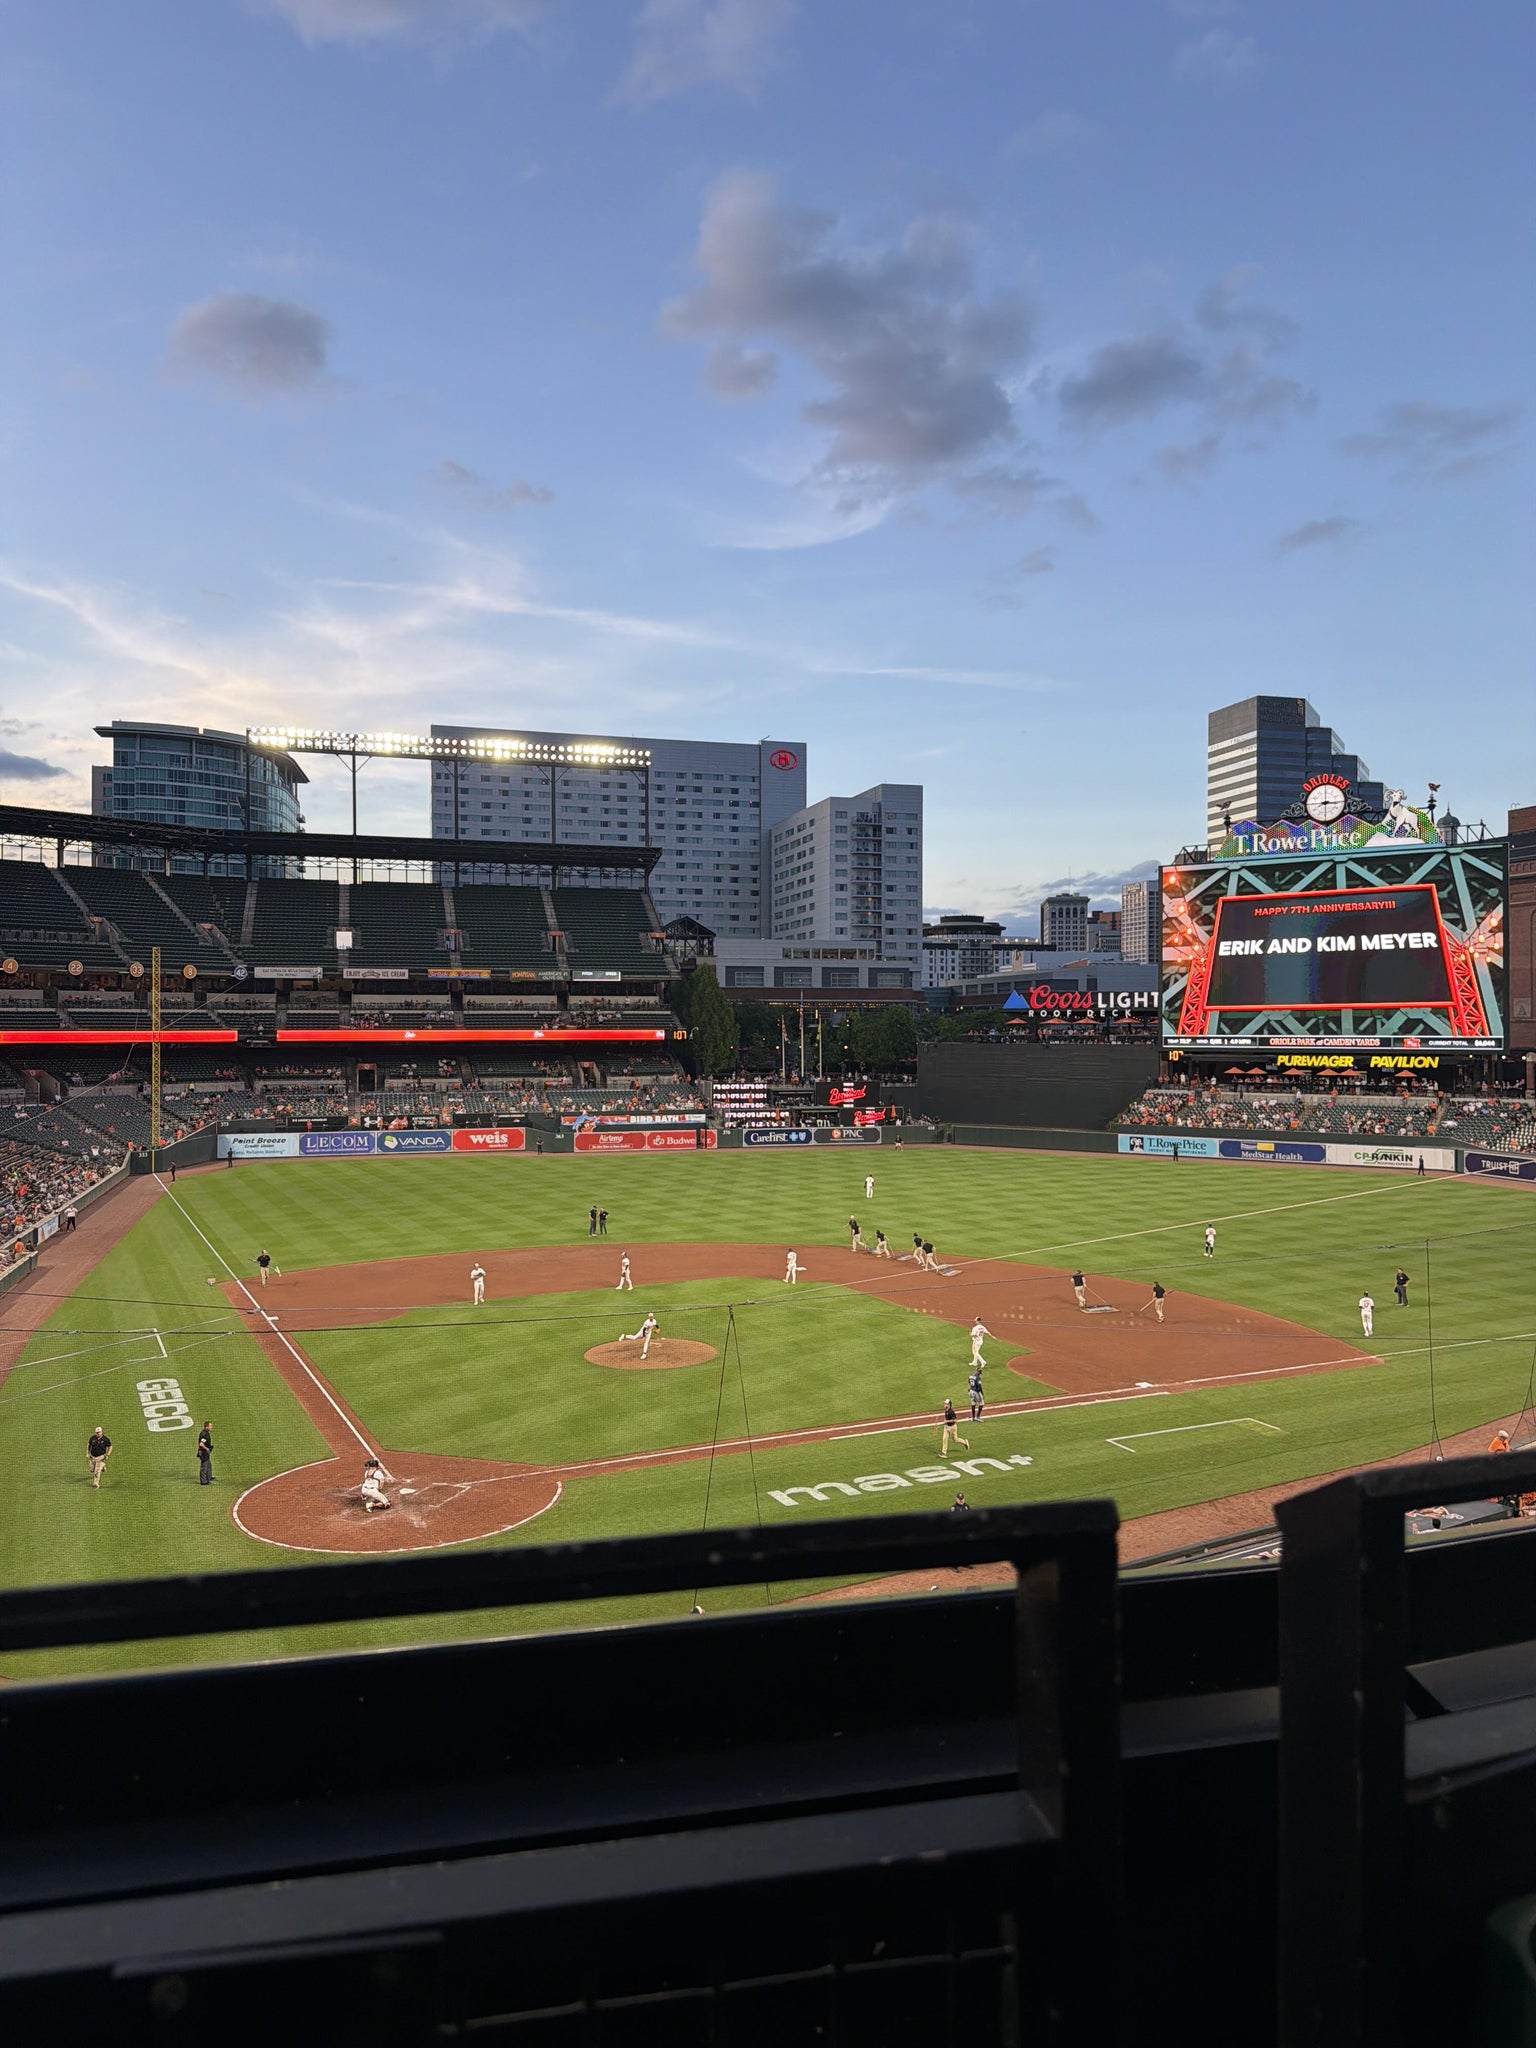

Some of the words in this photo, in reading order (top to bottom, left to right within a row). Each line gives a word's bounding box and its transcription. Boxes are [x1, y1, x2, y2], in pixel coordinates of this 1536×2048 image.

[1303, 773, 1350, 793] ORIOLES
[1310, 828, 1361, 849] Price
[1254, 907, 1288, 916] HAPPY
[1290, 906, 1310, 915] 7TH
[1218, 939, 1264, 956] ERIK
[1267, 937, 1312, 955] AND
[1317, 935, 1356, 952] KIM
[1361, 932, 1438, 951] MEYER
[71, 964, 80, 972] 22
[132, 965, 142, 974] 33
[236, 968, 246, 977] 42
[345, 969, 361, 977] ENJOY
[1028, 984, 1094, 1009] Coors
[1097, 991, 1159, 1008] LIGHT
[1029, 1009, 1072, 1018] ROOF
[1087, 1009, 1132, 1018] DECK
[673, 1030, 687, 1040] 1:07
[1269, 1038, 1297, 1046] ORIOLE
[1297, 1038, 1315, 1046] PARK
[1323, 1038, 1355, 1046] CAMDEN
[1355, 1038, 1380, 1046] YARDS
[1277, 1055, 1354, 1067] PUREWAGER
[1370, 1055, 1440, 1069] PAVILION
[630, 1115, 653, 1123] BIRD
[654, 1115, 679, 1123] BATH
[469, 1131, 508, 1144] weis
[750, 1132, 788, 1143] CareFirst
[842, 1129, 863, 1138] PNC
[306, 1136, 369, 1148] LECOM
[398, 1136, 445, 1146] VANDA
[599, 1135, 624, 1143] Airtemp
[1182, 1140, 1207, 1150] Price
[1242, 1151, 1275, 1160] MedStar
[1275, 1152, 1303, 1161] Health
[1481, 1159, 1507, 1170] TRUIST
[136, 1378, 194, 1432] GEICO
